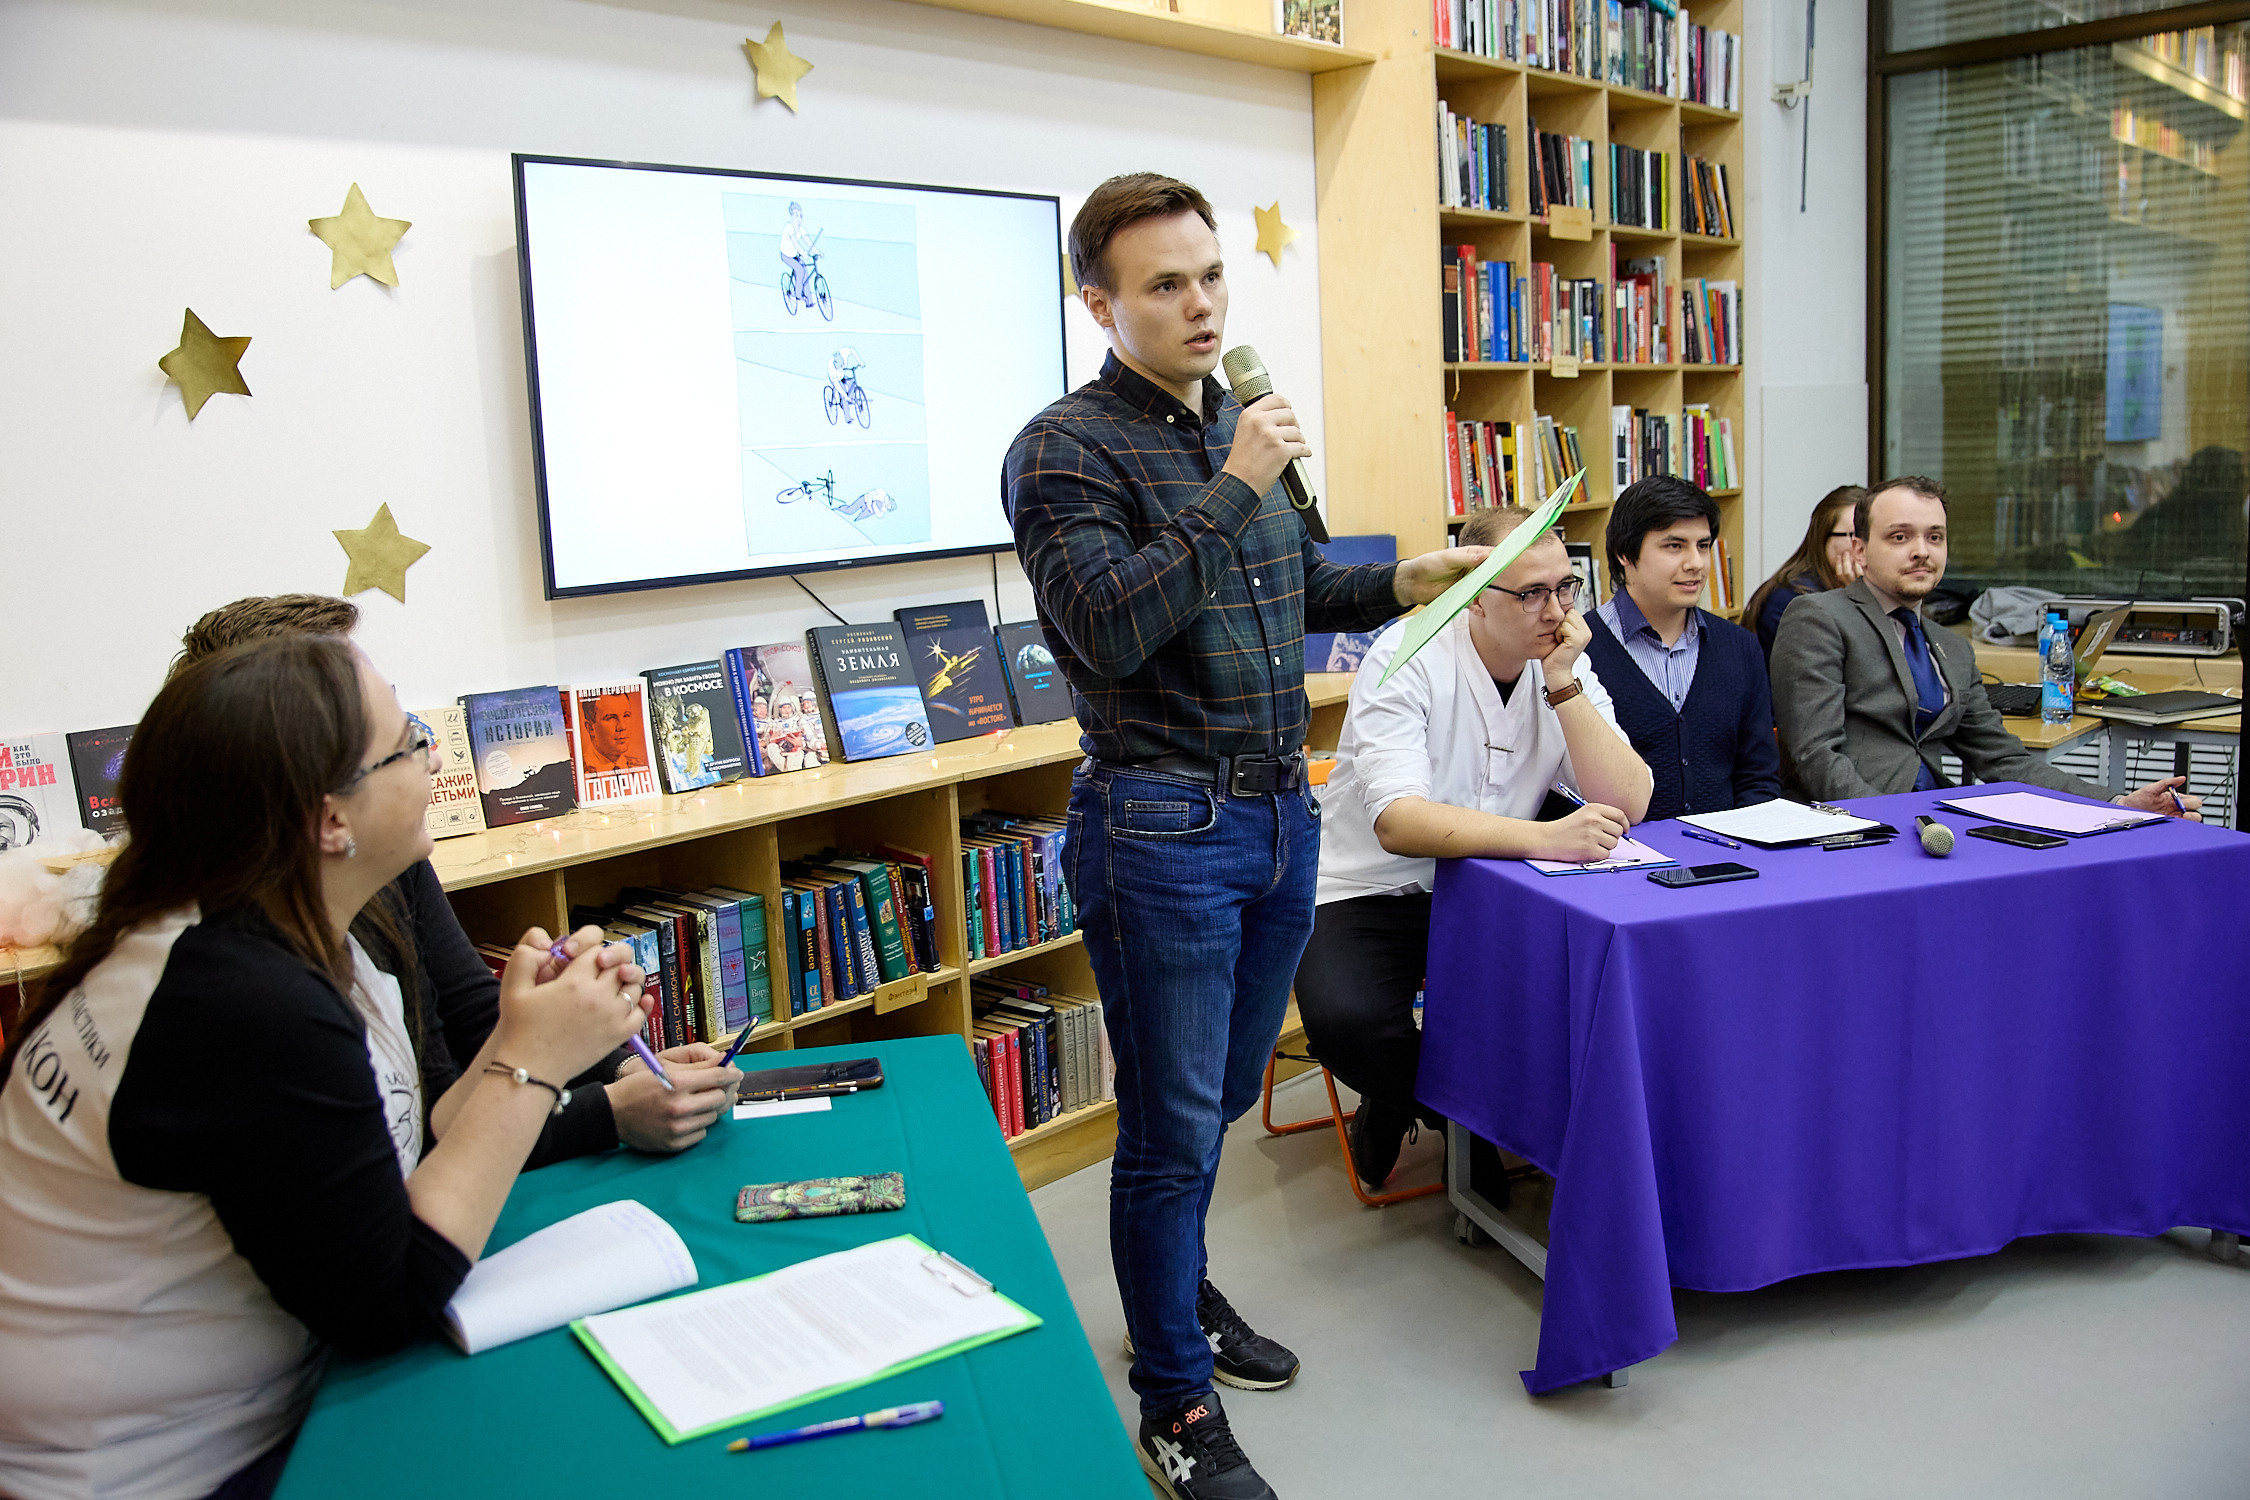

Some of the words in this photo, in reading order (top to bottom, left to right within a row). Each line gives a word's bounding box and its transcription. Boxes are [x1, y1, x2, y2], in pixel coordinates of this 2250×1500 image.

[841, 645, 889, 655] УДИВИТЕЛЬНАЯ
[837, 652, 900, 672] ЗЕМЛЯ
[653, 680, 675, 688] МОЖНО
[683, 675, 702, 683] ЗАБИТЬ
[702, 672, 722, 680] ГВОЗДЬ
[664, 687, 672, 697] В
[673, 679, 724, 696] КОСМОСЕ
[578, 687, 601, 698] АНТОН
[601, 684, 641, 696] ПЕРВУШИН
[969, 695, 984, 704] УТРО
[968, 702, 1003, 715] НАЧИНАЕТСЯ
[484, 720, 554, 744] ИСТОРИИ
[15, 752, 31, 760] ЭТО
[16, 758, 41, 767] БЫЛО
[585, 771, 655, 802] ГАГАРИН
[703, 955, 712, 981] СОЙЕР
[709, 916, 719, 963] ДЖОРДЖ
[714, 976, 724, 1020] СОНДЕРС
[669, 965, 681, 1017] СИММОНС
[707, 999, 716, 1028] РОБЕРТ
[70, 985, 111, 1071] ТАСТИКИ
[675, 1019, 684, 1041] ДЭН
[1185, 1404, 1207, 1424] asics
